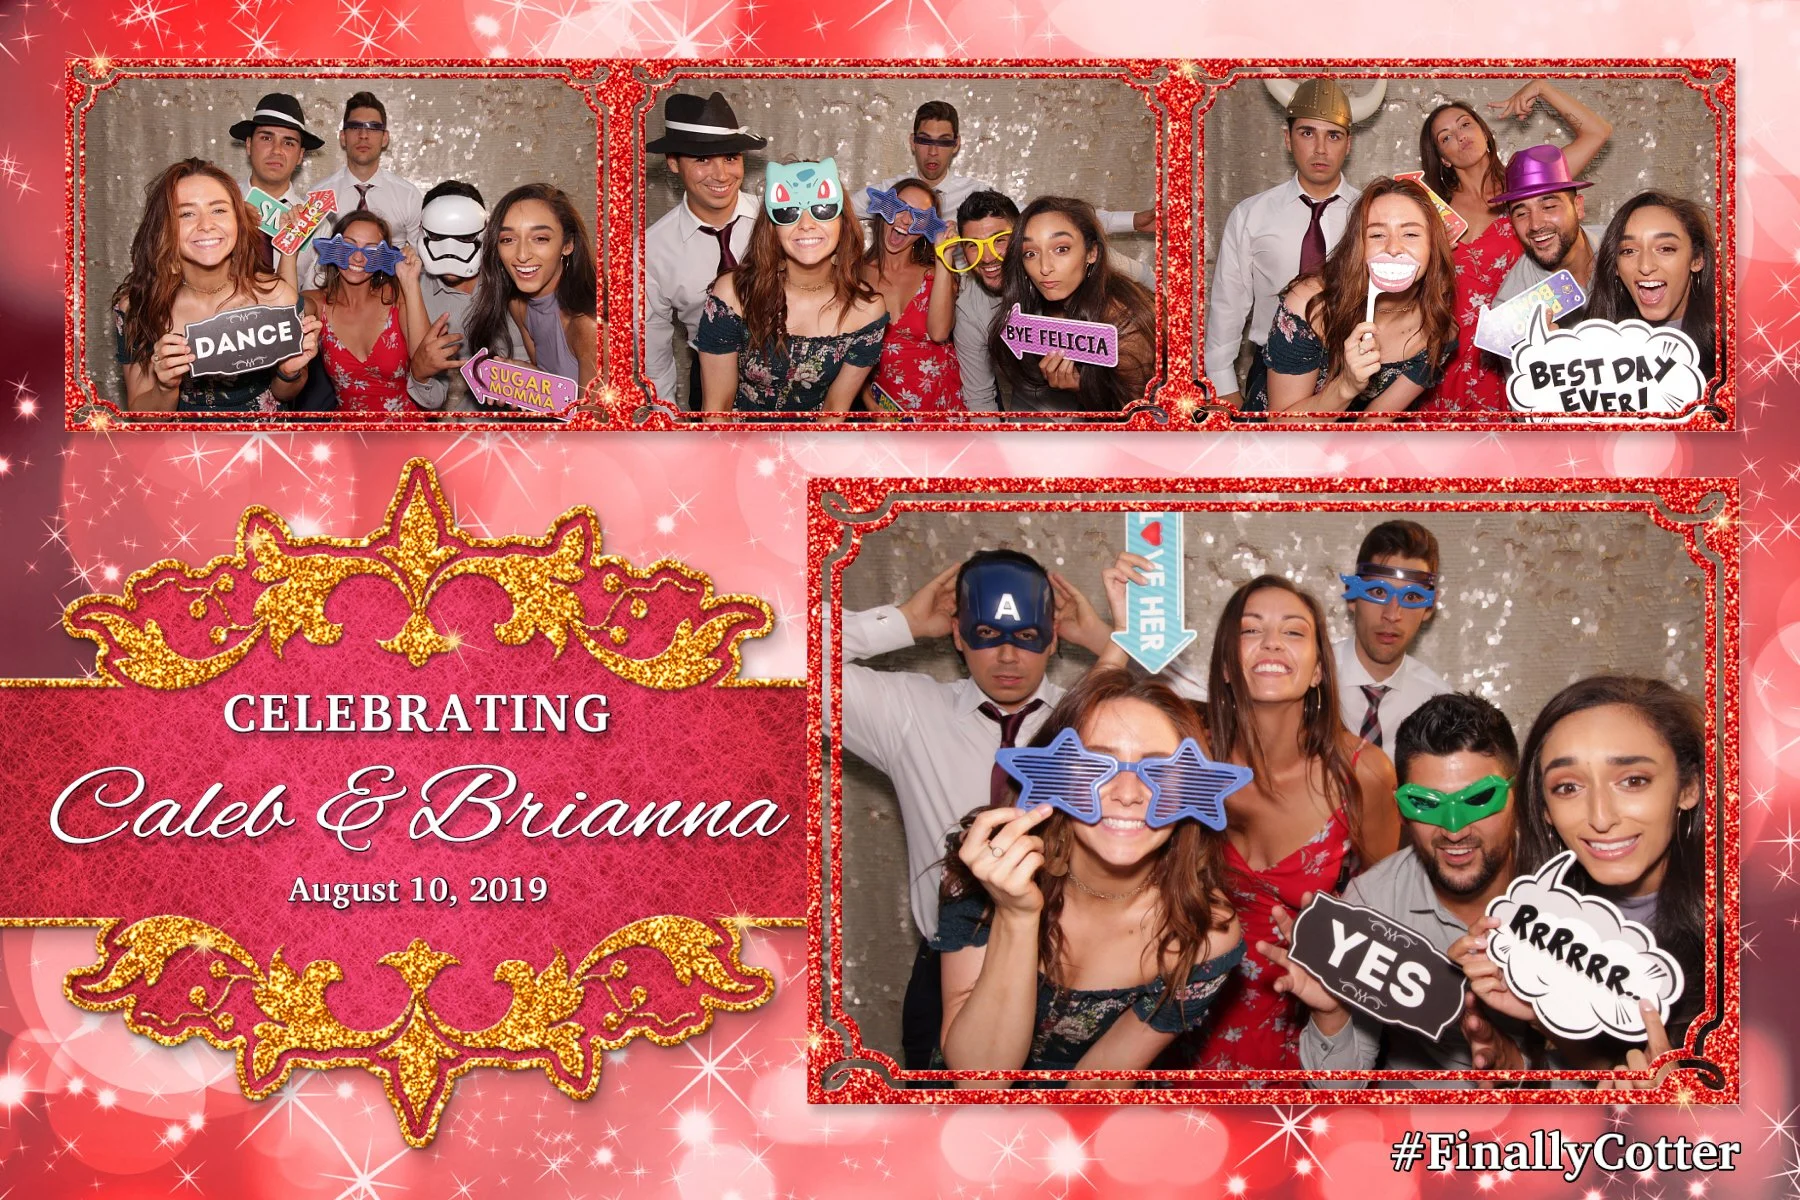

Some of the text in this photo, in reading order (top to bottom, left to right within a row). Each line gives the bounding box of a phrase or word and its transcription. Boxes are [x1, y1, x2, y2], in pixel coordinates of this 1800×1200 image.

[195, 321, 293, 359] DANCE
[1006, 325, 1108, 356] BYE FELICIA
[490, 366, 552, 395] SUGAR
[1529, 355, 1677, 390] BEST DAY
[489, 381, 555, 411] MOMMA
[1559, 386, 1649, 417] EVER!
[994, 593, 1021, 621] A
[1138, 596, 1165, 652] HER
[1328, 918, 1431, 1008] YES
